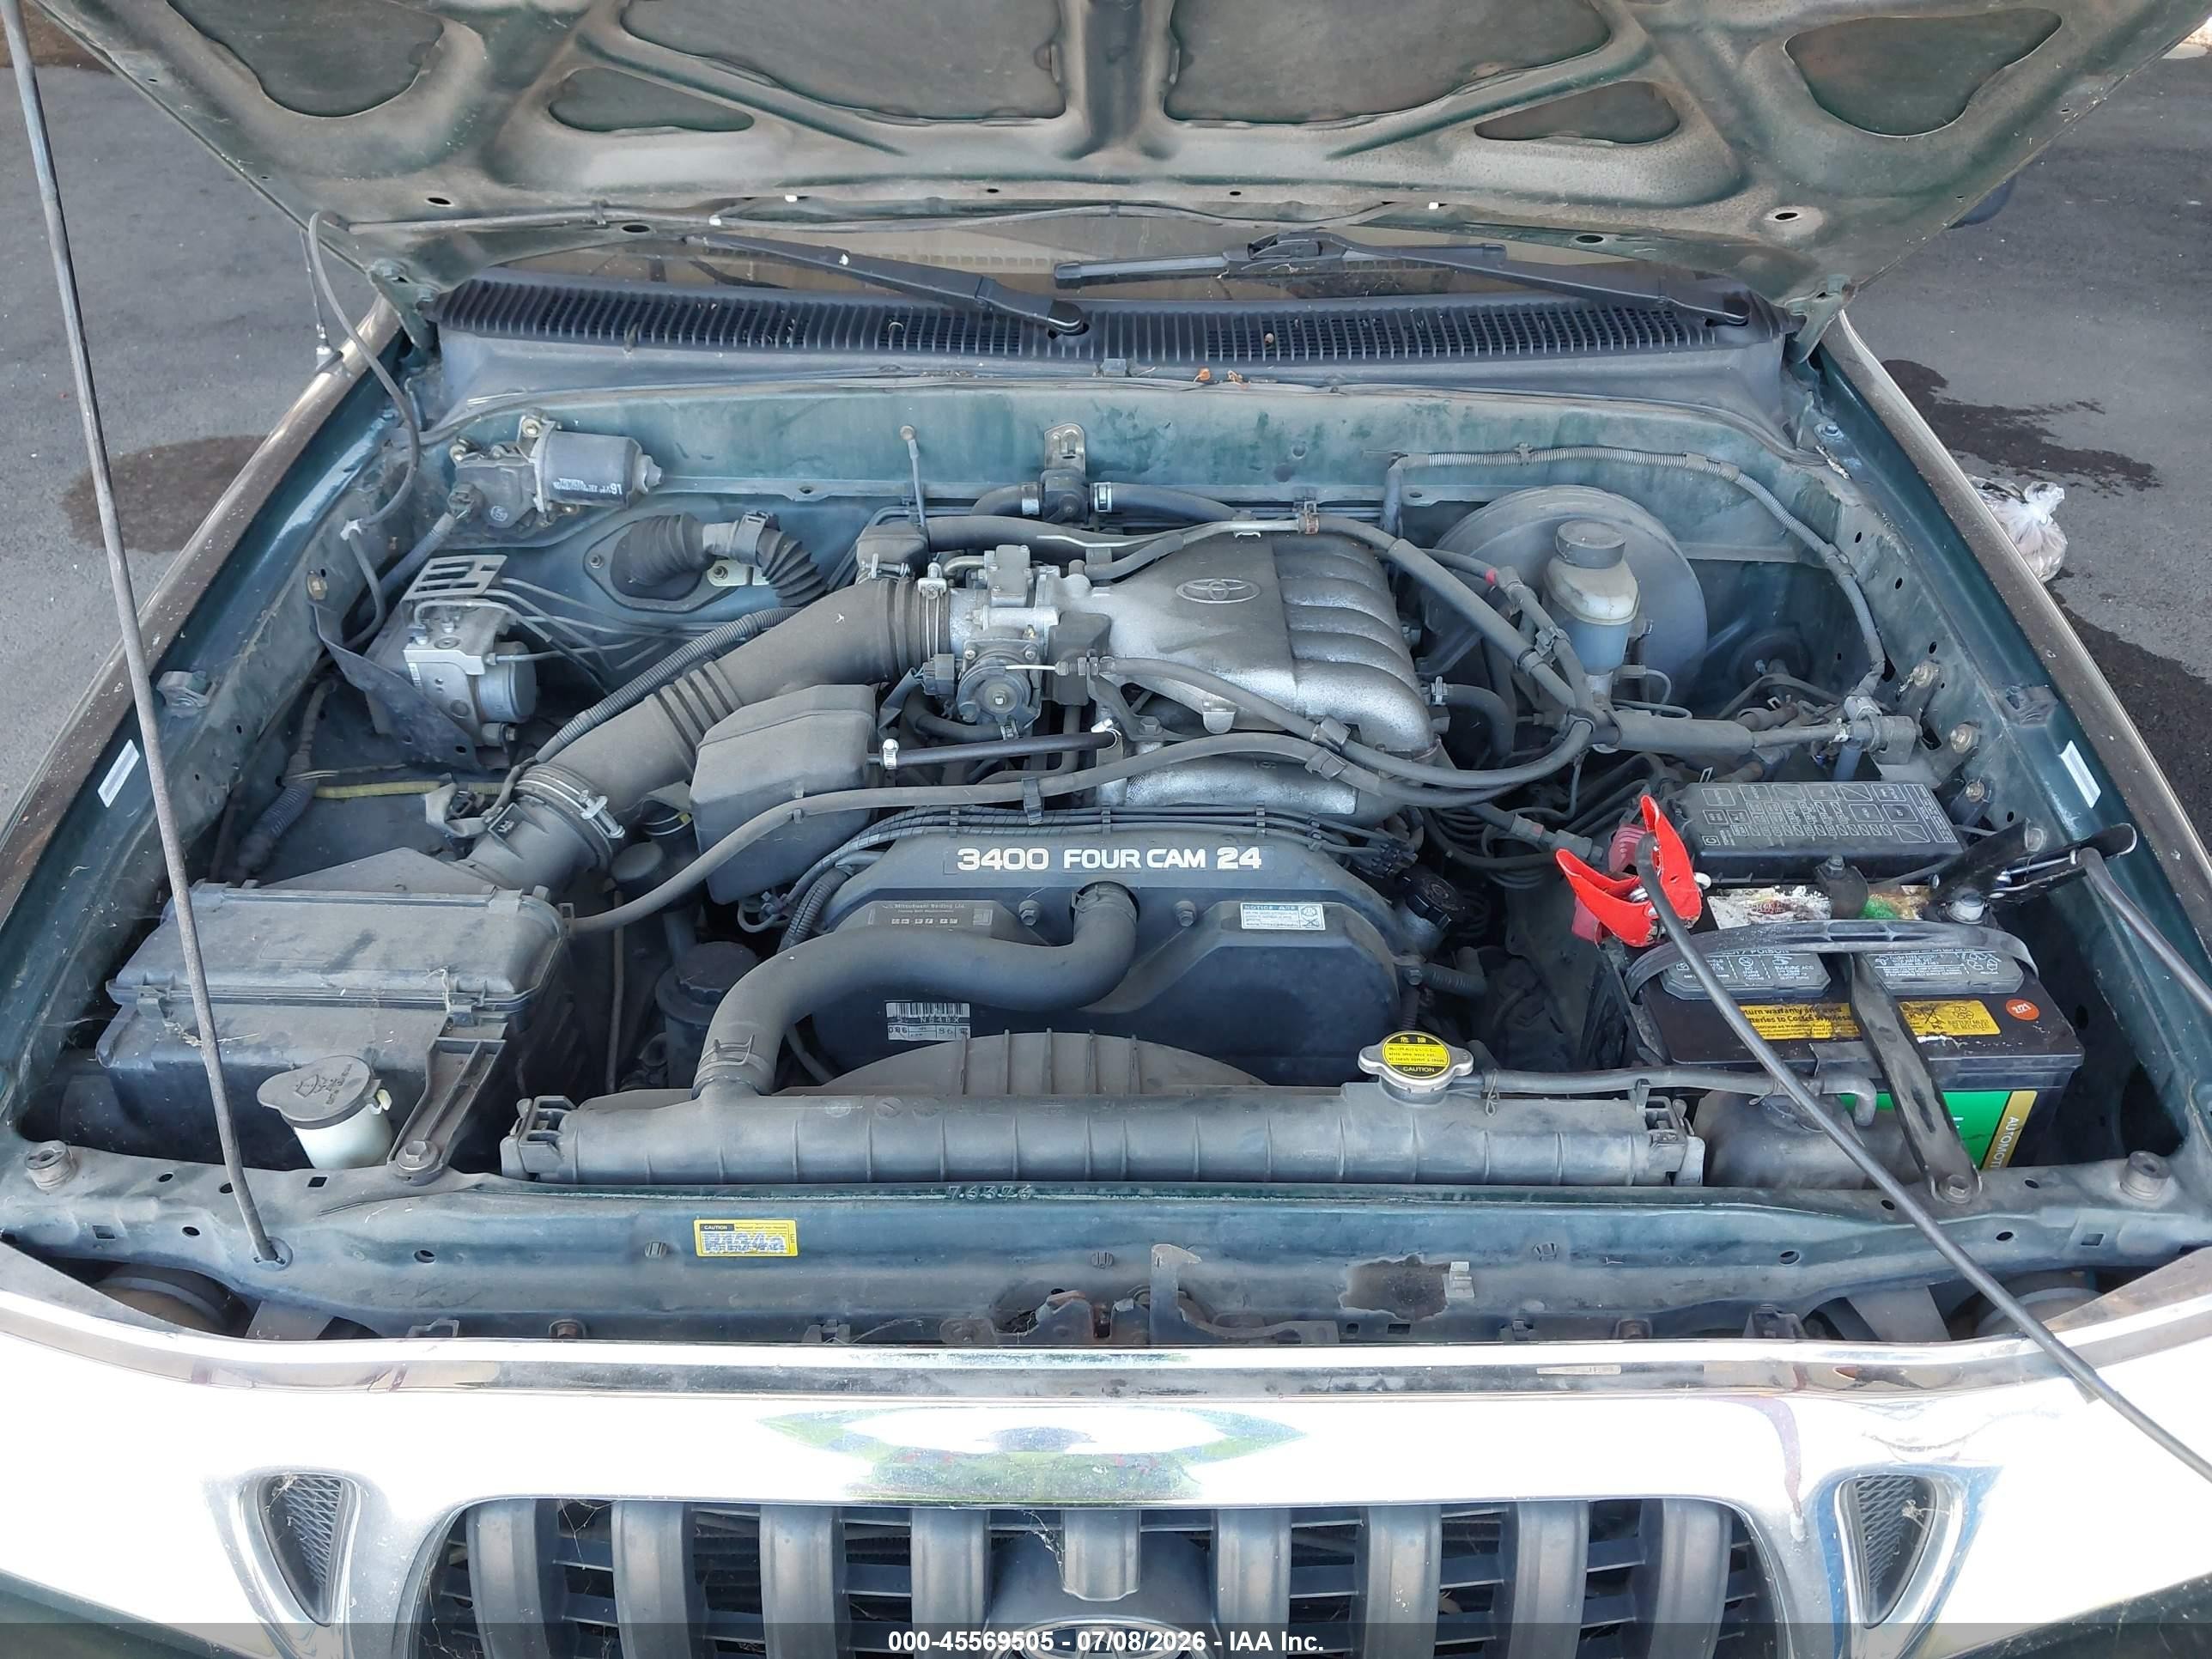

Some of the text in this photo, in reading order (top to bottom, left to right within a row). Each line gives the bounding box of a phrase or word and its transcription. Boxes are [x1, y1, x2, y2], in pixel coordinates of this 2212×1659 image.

[957, 847, 1262, 871] 3400 FOUR CAM 24
[1990, 1116, 2020, 1168] AUTOMOTI
